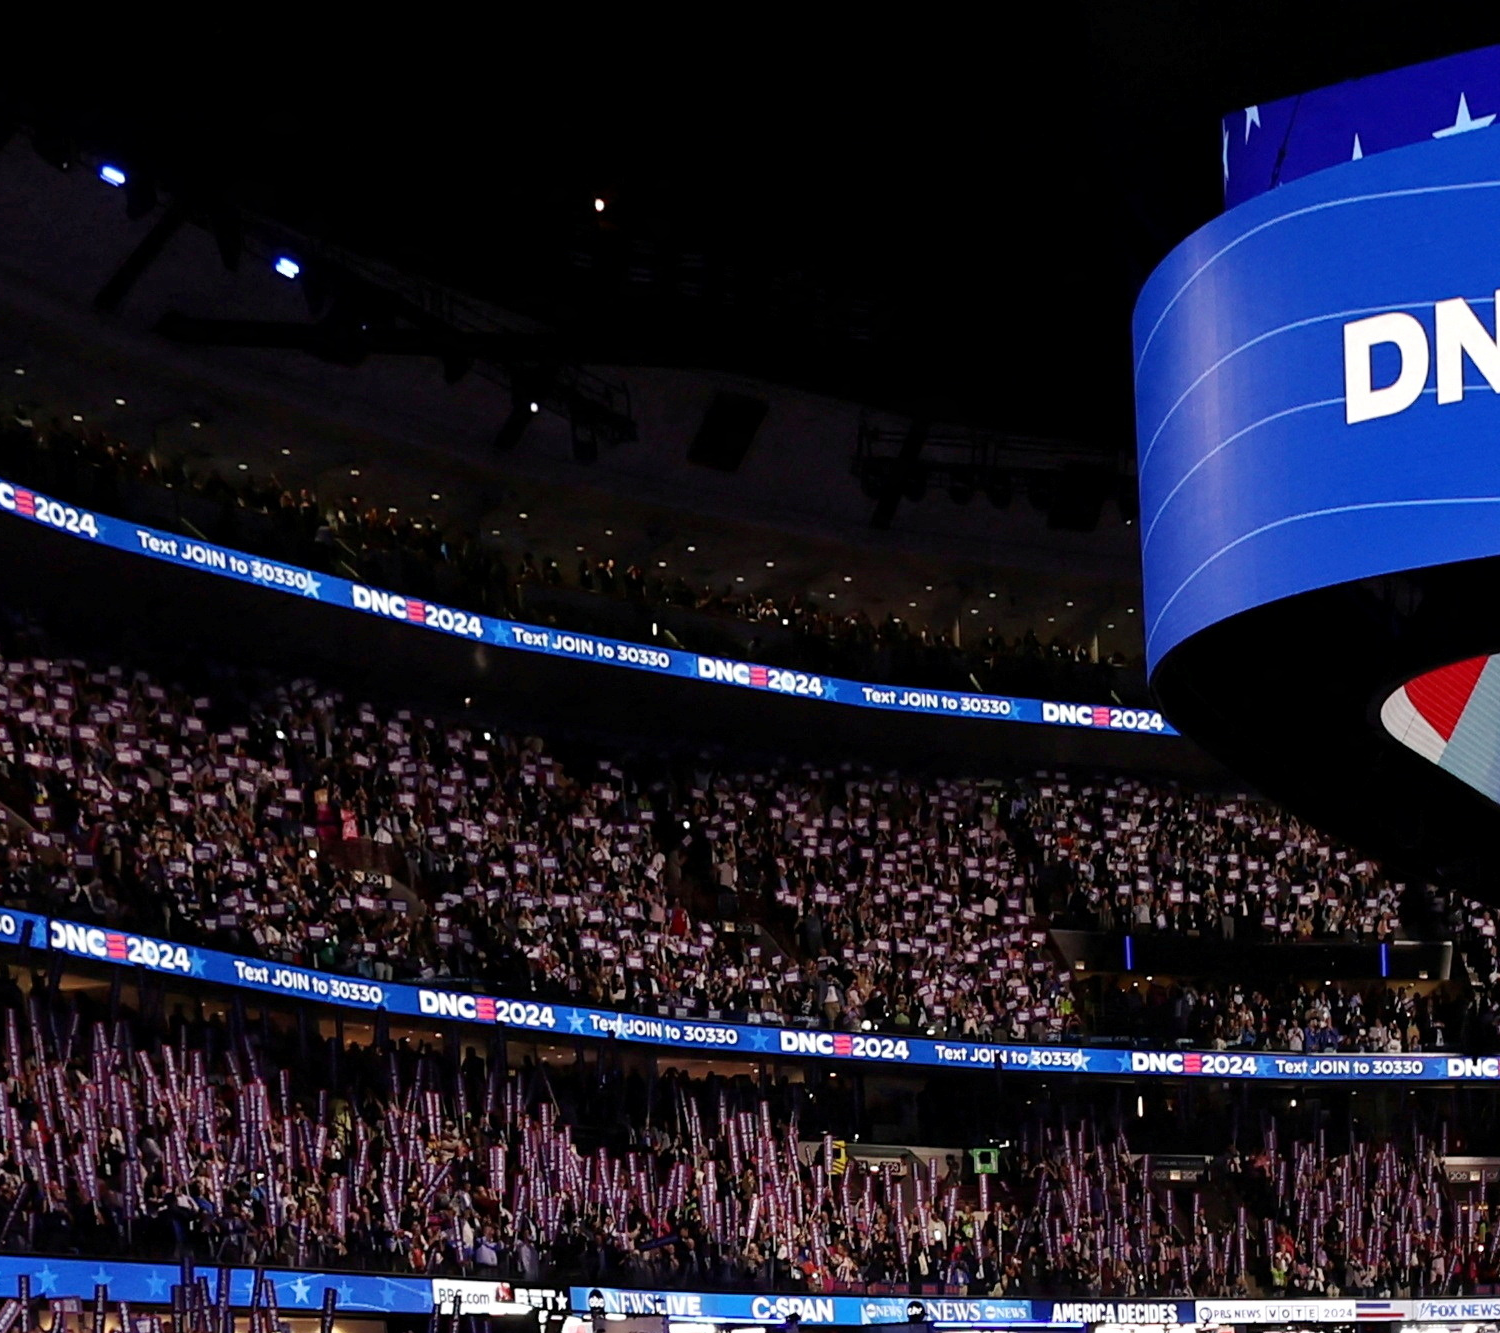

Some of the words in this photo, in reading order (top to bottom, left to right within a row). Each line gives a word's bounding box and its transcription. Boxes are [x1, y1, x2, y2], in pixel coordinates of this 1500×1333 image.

[512, 628, 548, 646] Text
[552, 635, 593, 654] JOIN
[597, 643, 614, 658] to
[618, 646, 669, 667] 30330
[1275, 1060, 1308, 1073] Text
[1311, 1061, 1349, 1074] JOIN
[1353, 1061, 1369, 1074] to
[1373, 1061, 1422, 1074] 30330
[926, 1302, 981, 1321] NEWS
[1052, 1303, 1115, 1323] AMERICA
[1118, 1304, 1178, 1323] DECIDES
[1461, 1303, 1500, 1316] NEWS
